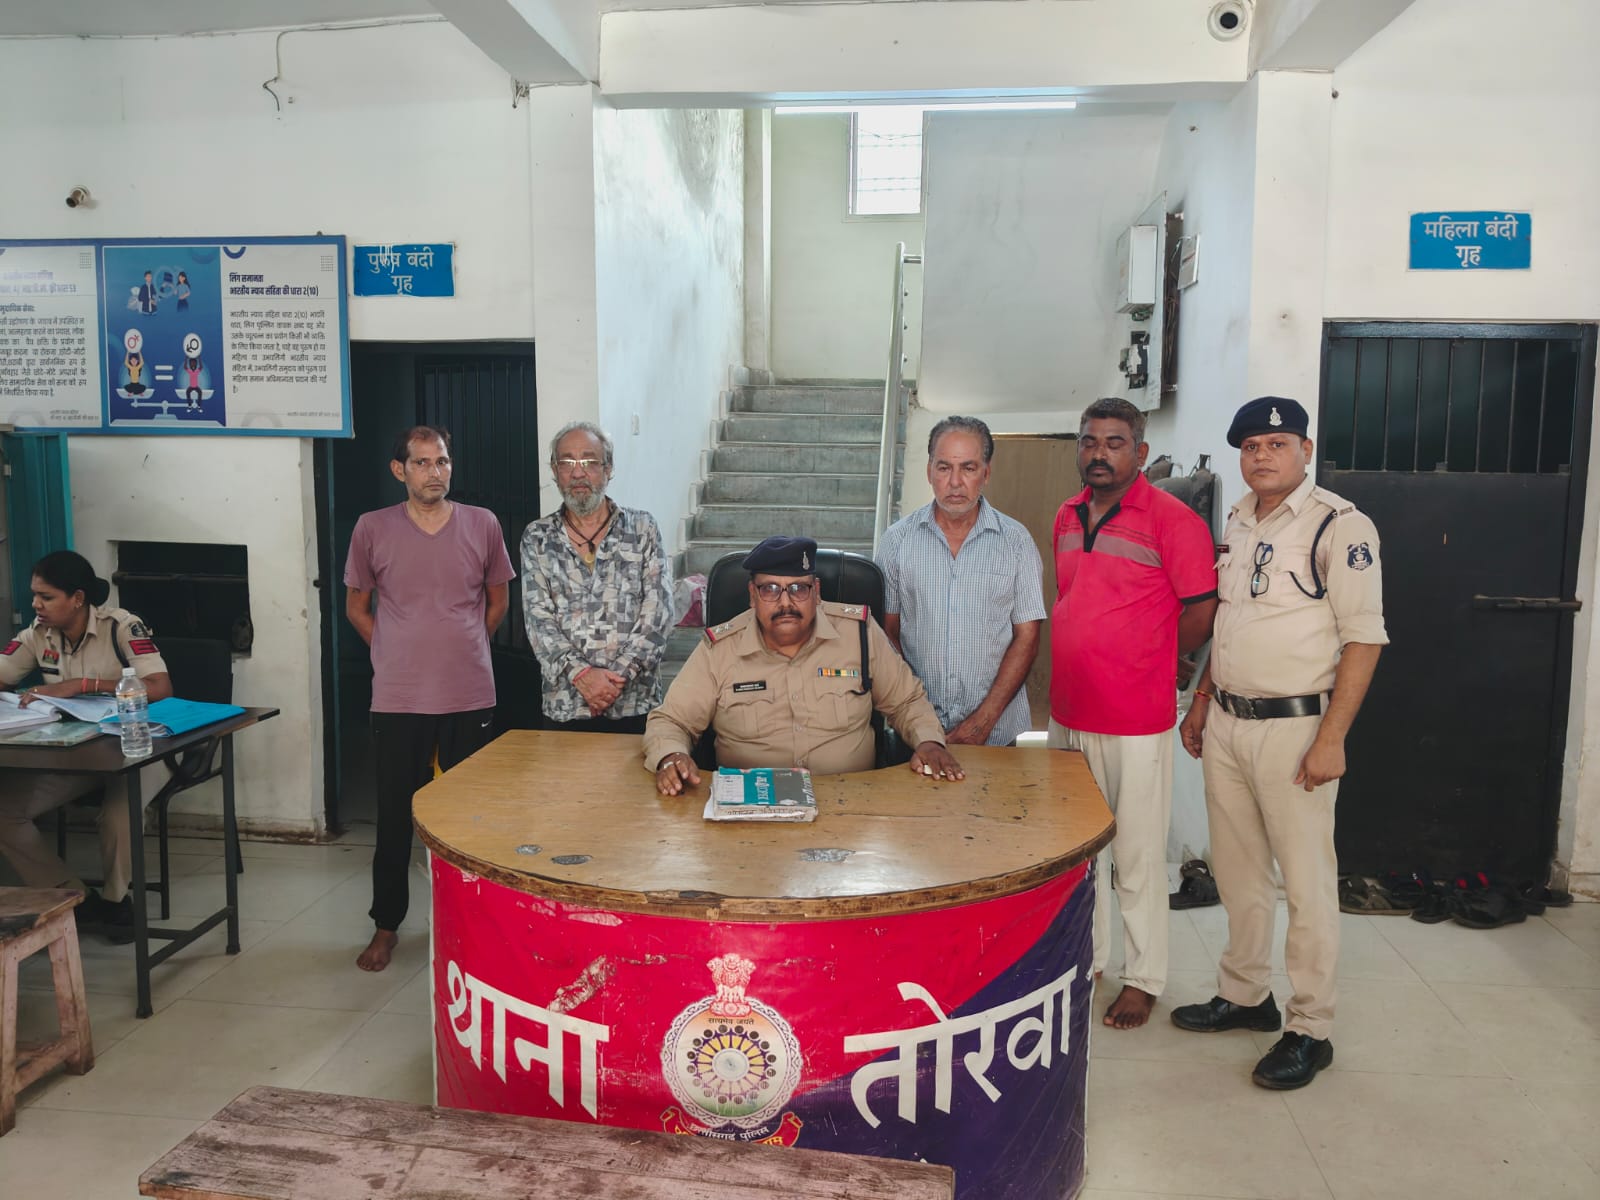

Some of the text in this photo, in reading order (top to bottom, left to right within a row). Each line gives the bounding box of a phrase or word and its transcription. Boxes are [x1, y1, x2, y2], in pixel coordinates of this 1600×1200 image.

[1423, 214, 1518, 240] महिला बंदी
[406, 246, 434, 270] बंदी
[1454, 245, 1482, 267] गृह
[303, 286, 319, 297] 2(10)
[391, 275, 413, 294] गृह
[447, 960, 1078, 1128] थाना तोरवा
[739, 1126, 769, 1141] पुलिस
